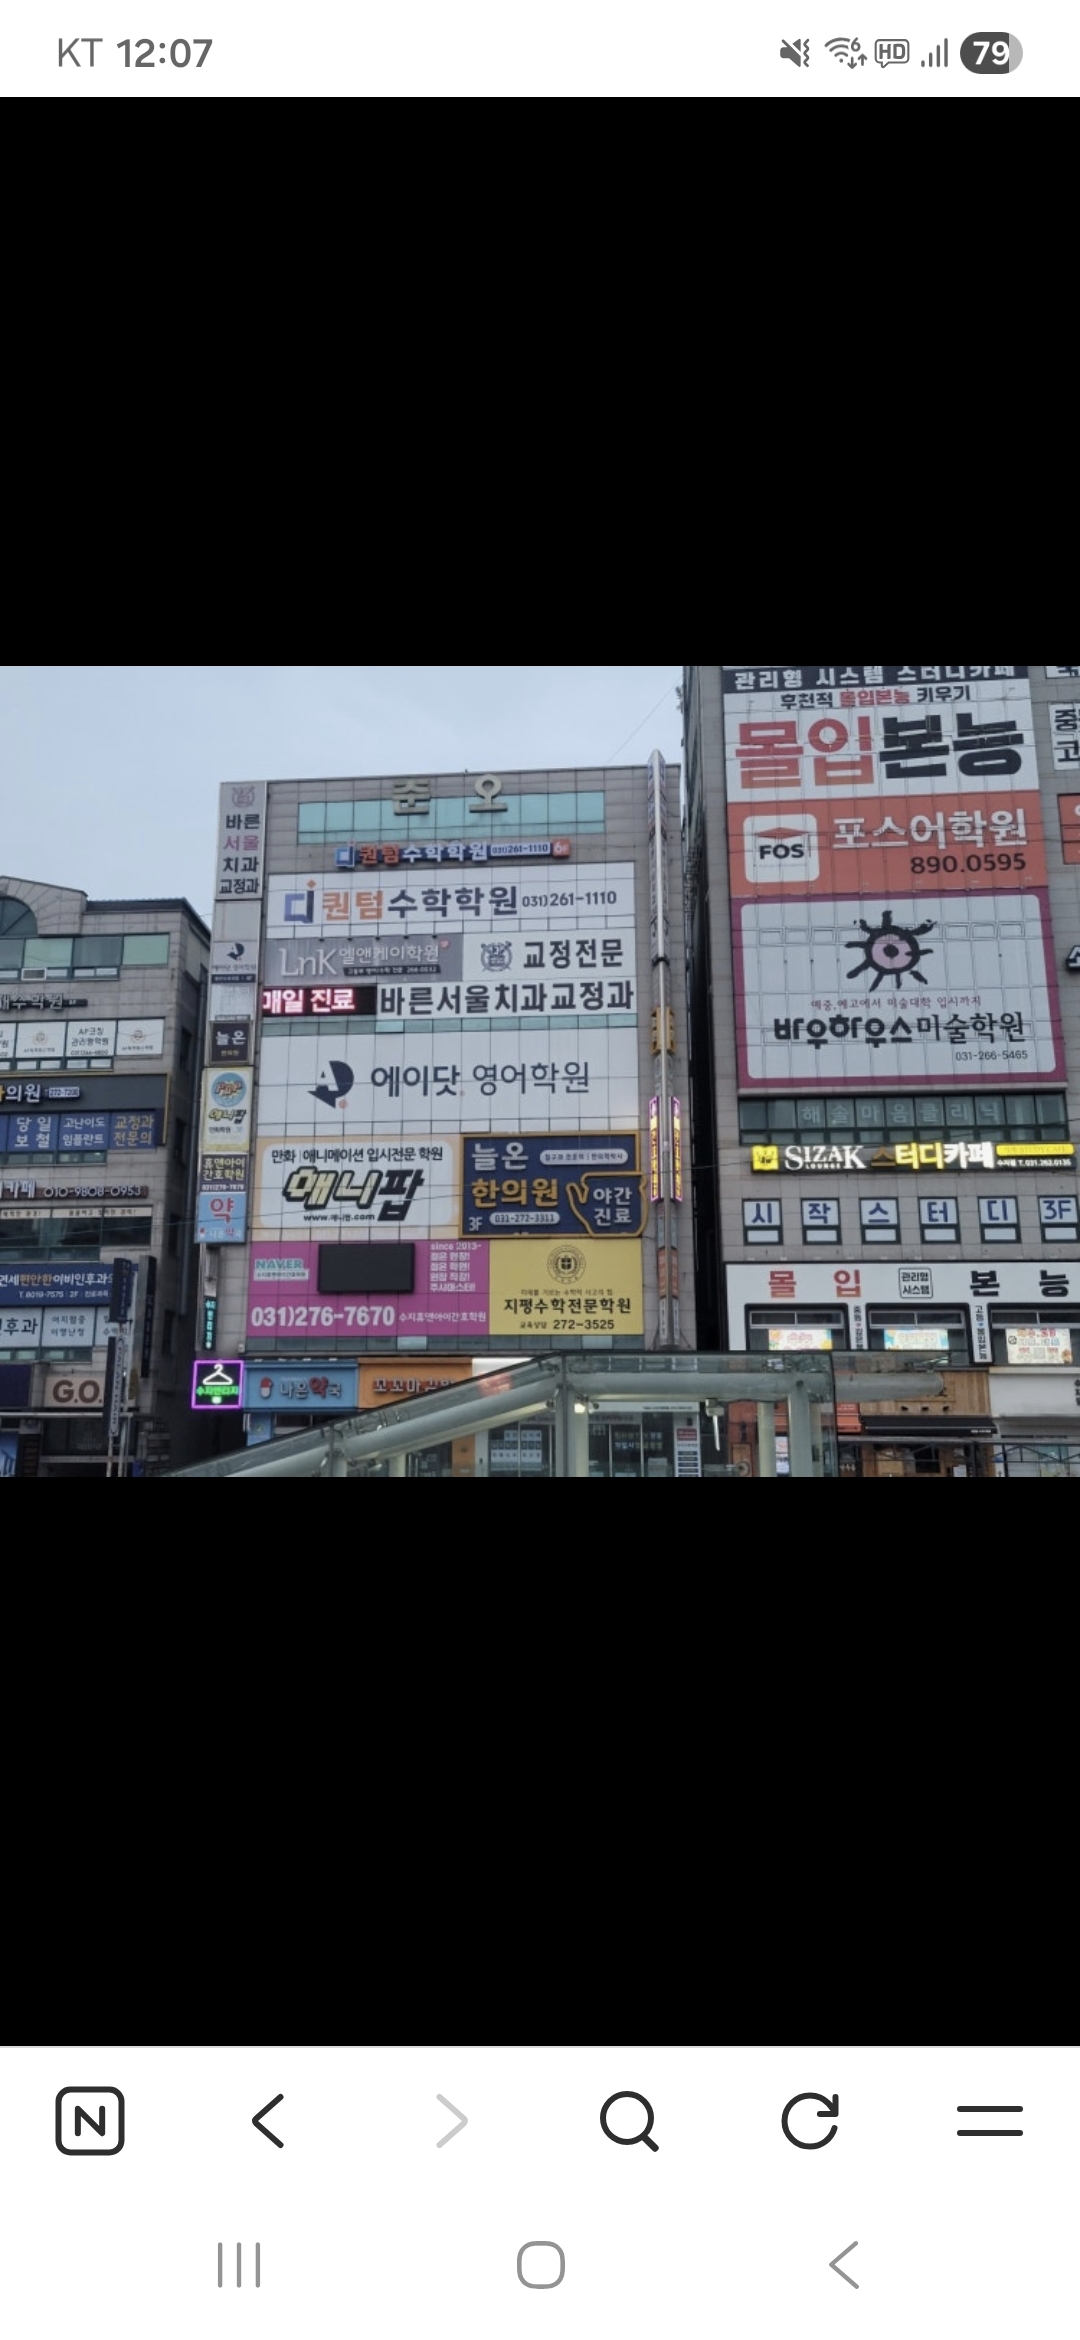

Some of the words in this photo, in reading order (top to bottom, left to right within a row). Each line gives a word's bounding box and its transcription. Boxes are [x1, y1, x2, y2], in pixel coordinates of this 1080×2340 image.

[735, 671, 802, 690] 관리형
[816, 667, 884, 687] 시스템
[780, 692, 833, 709] 후천적
[839, 688, 910, 707] 몰입본능
[917, 685, 970, 702] 키우기
[735, 713, 1024, 789] 몰입본능
[226, 814, 260, 830] 바른
[833, 808, 1027, 849] 포스어학원
[224, 835, 260, 851] 서울
[759, 844, 804, 859] FOS
[223, 856, 259, 873] 치과
[911, 853, 1026, 874] 890.0595
[219, 878, 259, 894] 교정과
[322, 886, 518, 921] 퀀텀수학학원
[522, 890, 617, 908] 031)261-1110
[280, 947, 337, 977] LnK
[340, 944, 439, 966] 엘앤케이학원
[523, 939, 624, 969] 교정전문
[310, 987, 355, 1012] 진료
[380, 979, 634, 1016] 바른서울치과교정과
[887, 997, 931, 1009] 미술대학
[937, 995, 981, 1007] 입시까지
[216, 1030, 247, 1046] 늘온
[774, 1011, 1026, 1049] 바우하우스미술학원
[955, 1050, 1028, 1061] 031-266-5465
[472, 1061, 589, 1096] 영어학원
[63, 1117, 105, 1129] 고난이도
[115, 1115, 154, 1130] 교정과
[63, 1133, 104, 1147] 임플란트
[114, 1132, 152, 1146] 전문의
[271, 1149, 297, 1164] 만화
[303, 1148, 364, 1163] 애니메이션
[366, 1147, 417, 1162] 입시전문
[419, 1146, 443, 1161] 학원
[472, 1142, 529, 1171] 늘온
[785, 1145, 867, 1171] SIZAK
[870, 1141, 996, 1170] 스터디카페
[282, 1166, 425, 1221] 애니팝
[472, 1178, 559, 1208] 한의원
[593, 1187, 633, 1205] 야간
[210, 1197, 234, 1224] 약
[494, 1213, 555, 1223] 031-272-3311
[594, 1208, 633, 1227] 진료
[1042, 1200, 1071, 1219] 3F
[468, 1217, 483, 1231] 3F
[255, 1259, 304, 1270] NAVER
[902, 1284, 931, 1295] 시스템
[251, 1305, 395, 1327] 031)276-7670
[504, 1298, 631, 1315] 지평수학전문학원
[553, 1319, 615, 1330] 272-3525
[52, 1379, 102, 1404] G.O.
[280, 1376, 342, 1399] 나은약국
